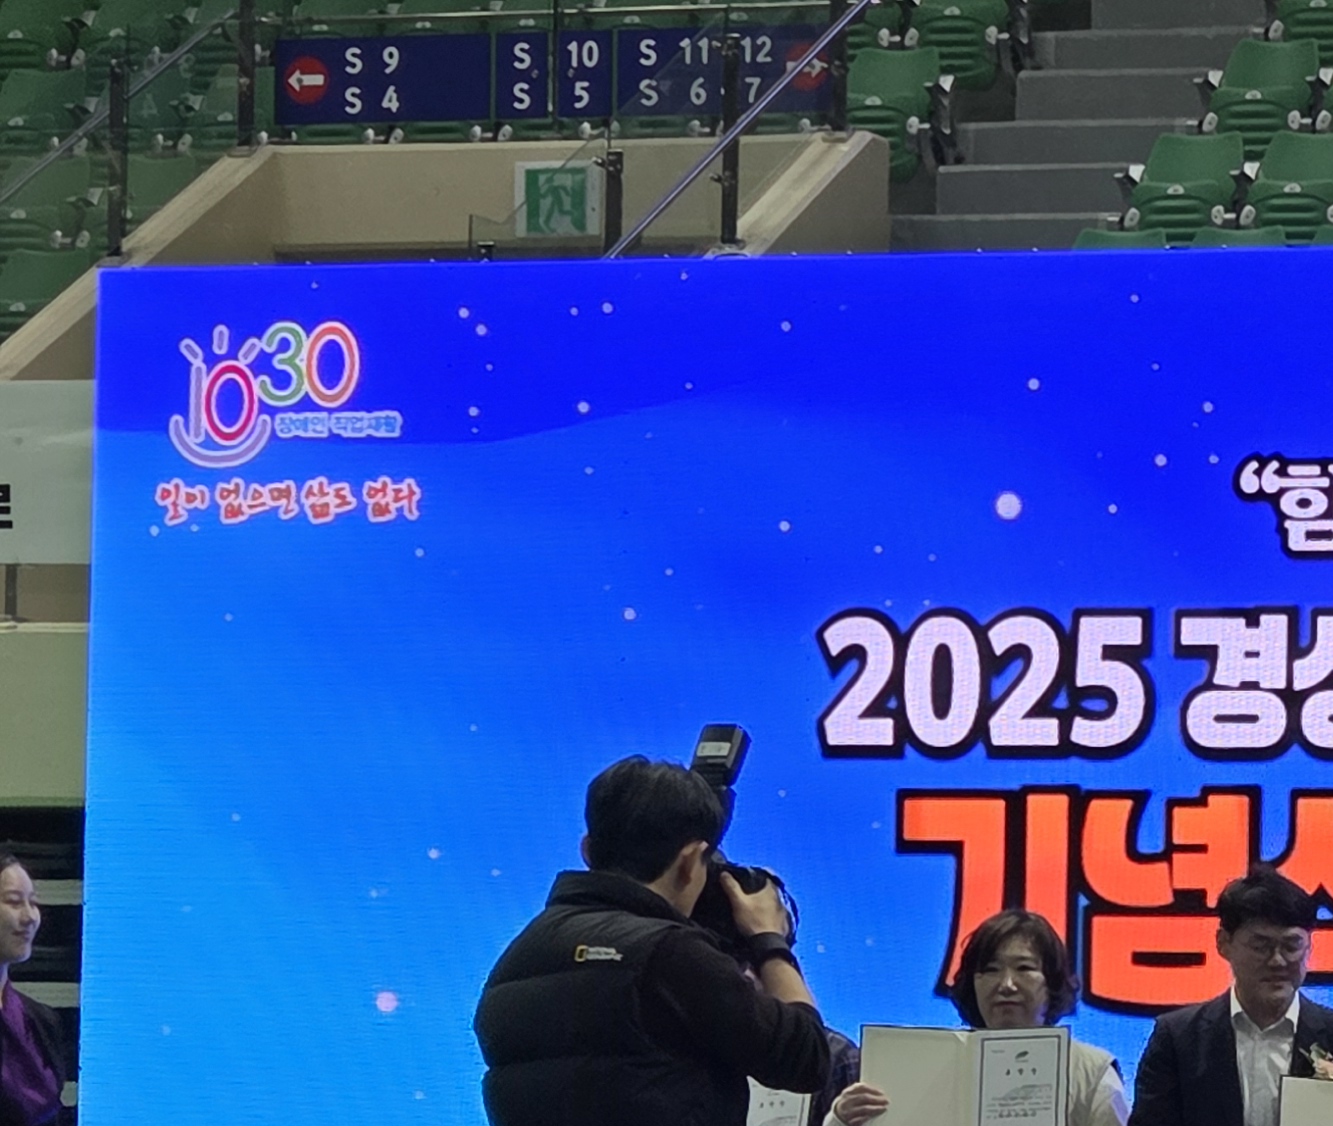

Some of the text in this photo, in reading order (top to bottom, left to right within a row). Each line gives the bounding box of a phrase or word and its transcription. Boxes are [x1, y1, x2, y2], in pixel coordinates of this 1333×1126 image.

[345, 45, 400, 75] S 9
[513, 40, 600, 69] S 10
[639, 35, 773, 66] S 11 12
[344, 86, 400, 115] S 4
[512, 81, 590, 109] S 5
[639, 76, 762, 107] S 6 7
[215, 477, 300, 525] 없으면
[362, 476, 421, 524] 없다
[820, 615, 1144, 750] 2025
